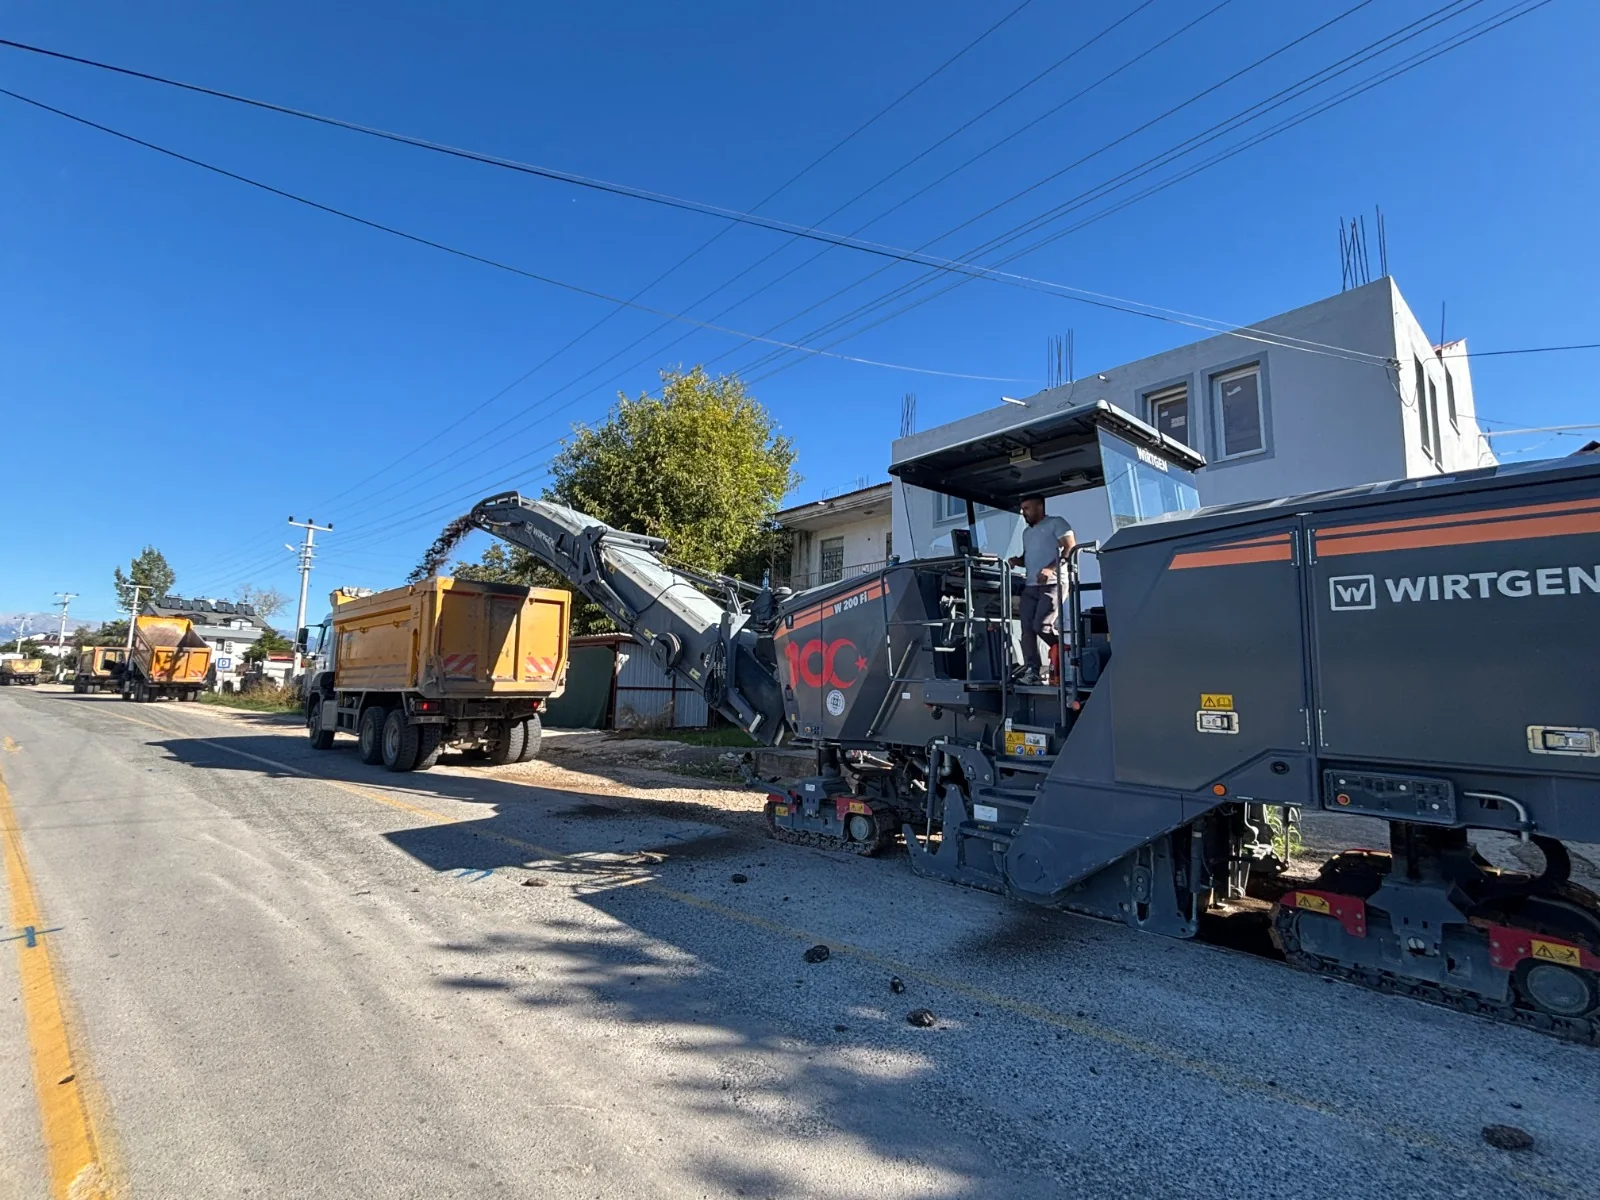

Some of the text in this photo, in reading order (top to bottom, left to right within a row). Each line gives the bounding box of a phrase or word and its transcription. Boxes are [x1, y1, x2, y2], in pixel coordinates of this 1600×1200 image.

[1384, 565, 1600, 603] WIRTGEN
[833, 602, 842, 614] W
[843, 596, 859, 611] 200
